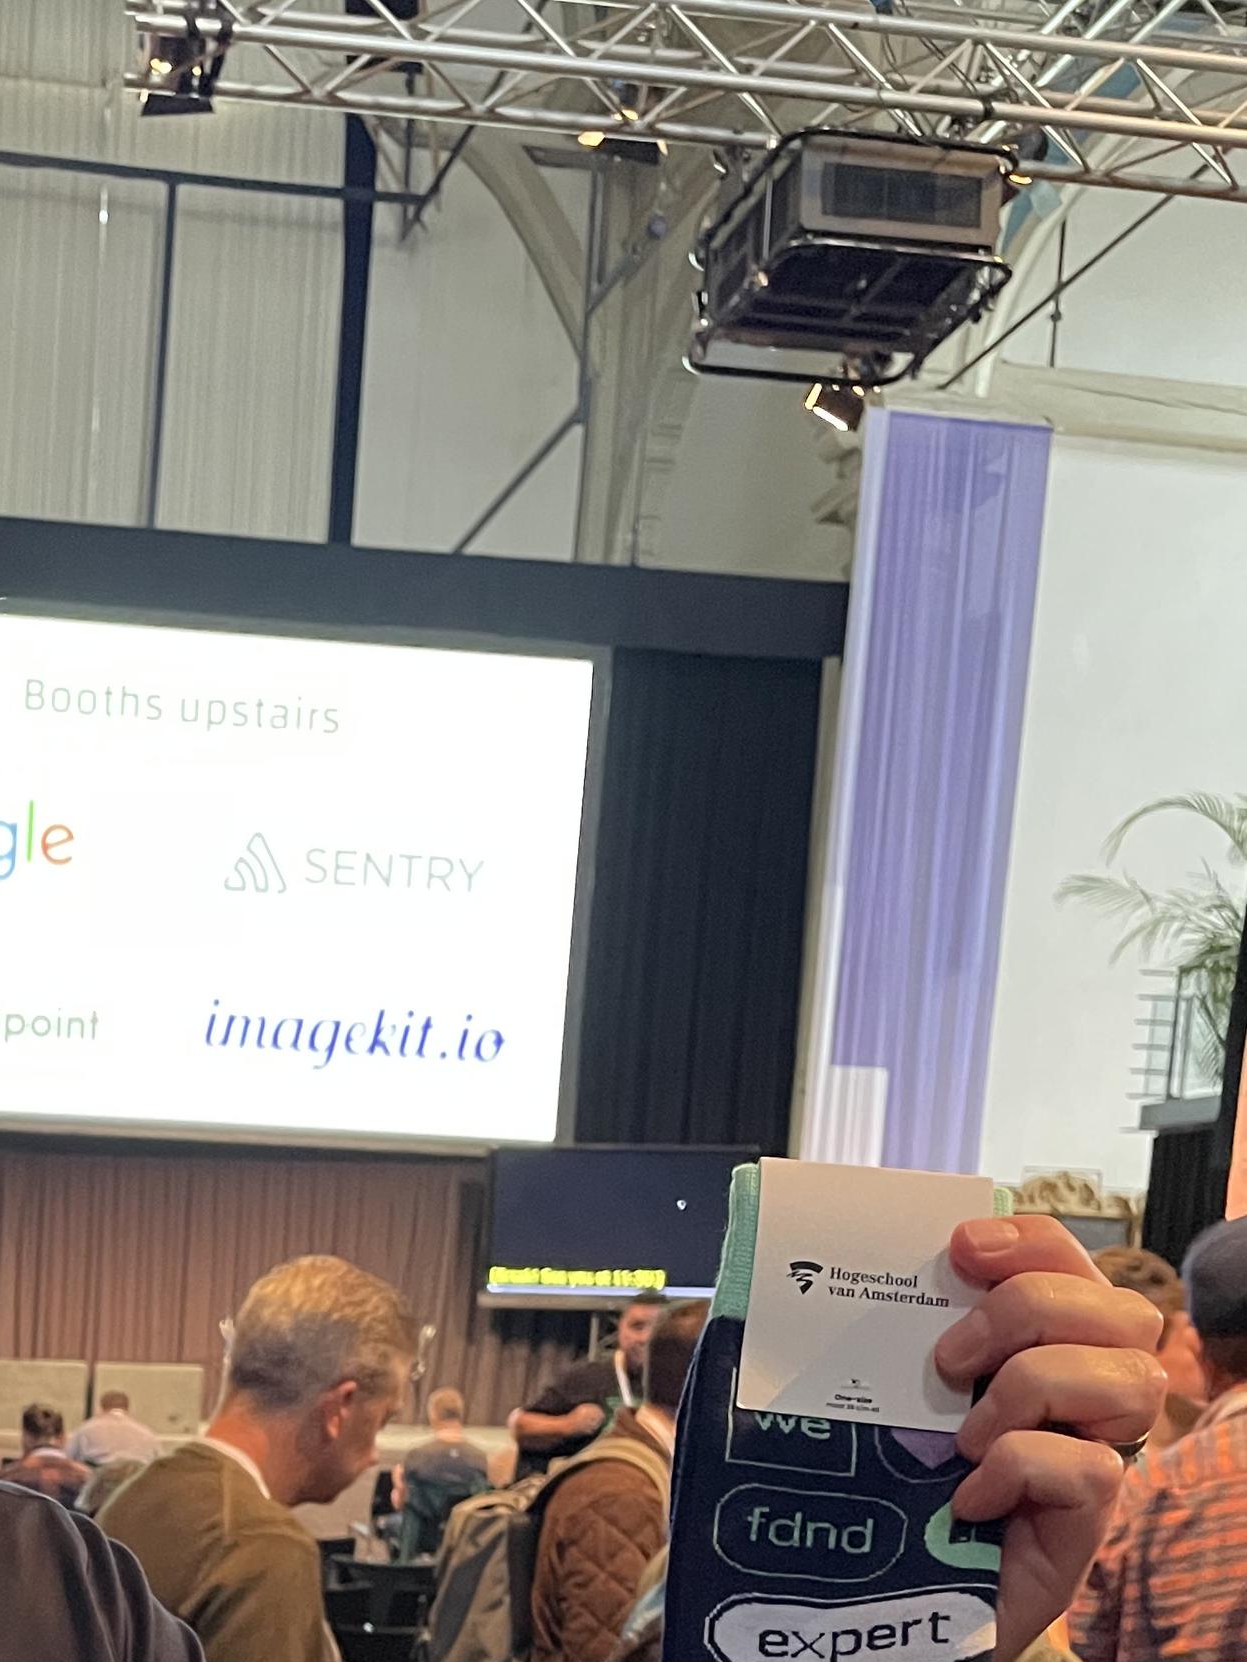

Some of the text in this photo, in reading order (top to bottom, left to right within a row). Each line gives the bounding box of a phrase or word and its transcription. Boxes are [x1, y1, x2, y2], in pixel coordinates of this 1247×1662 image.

[24, 678, 341, 735] Booths upstairs
[304, 847, 485, 893] SENTRY
[204, 999, 506, 1071] imagekit.io
[828, 1284, 950, 1309] van Amsterdam
[829, 1266, 918, 1290] Hogeschool
[747, 1506, 874, 1554] fdnd
